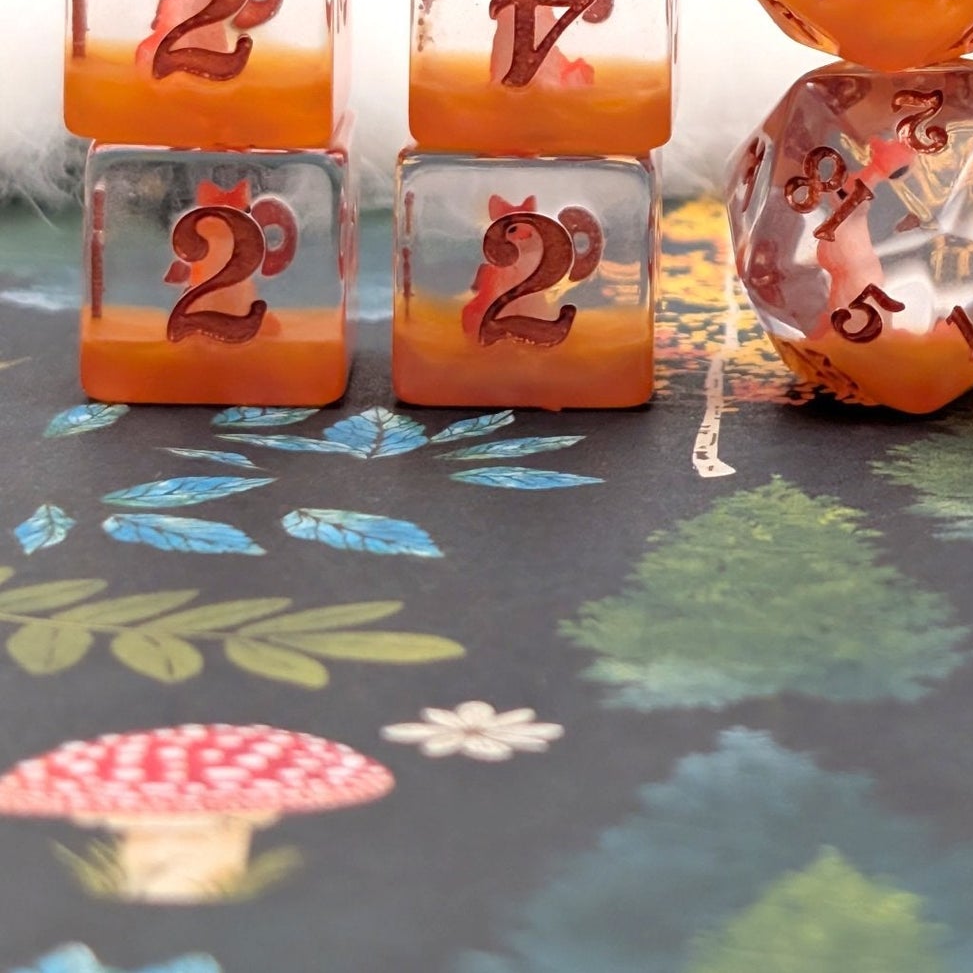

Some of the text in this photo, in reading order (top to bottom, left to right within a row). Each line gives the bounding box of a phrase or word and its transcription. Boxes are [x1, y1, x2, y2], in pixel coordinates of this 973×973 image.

[891, 89, 949, 154] 2
[167, 205, 267, 345] 2
[479, 210, 577, 347] 2
[830, 283, 906, 344] 5
